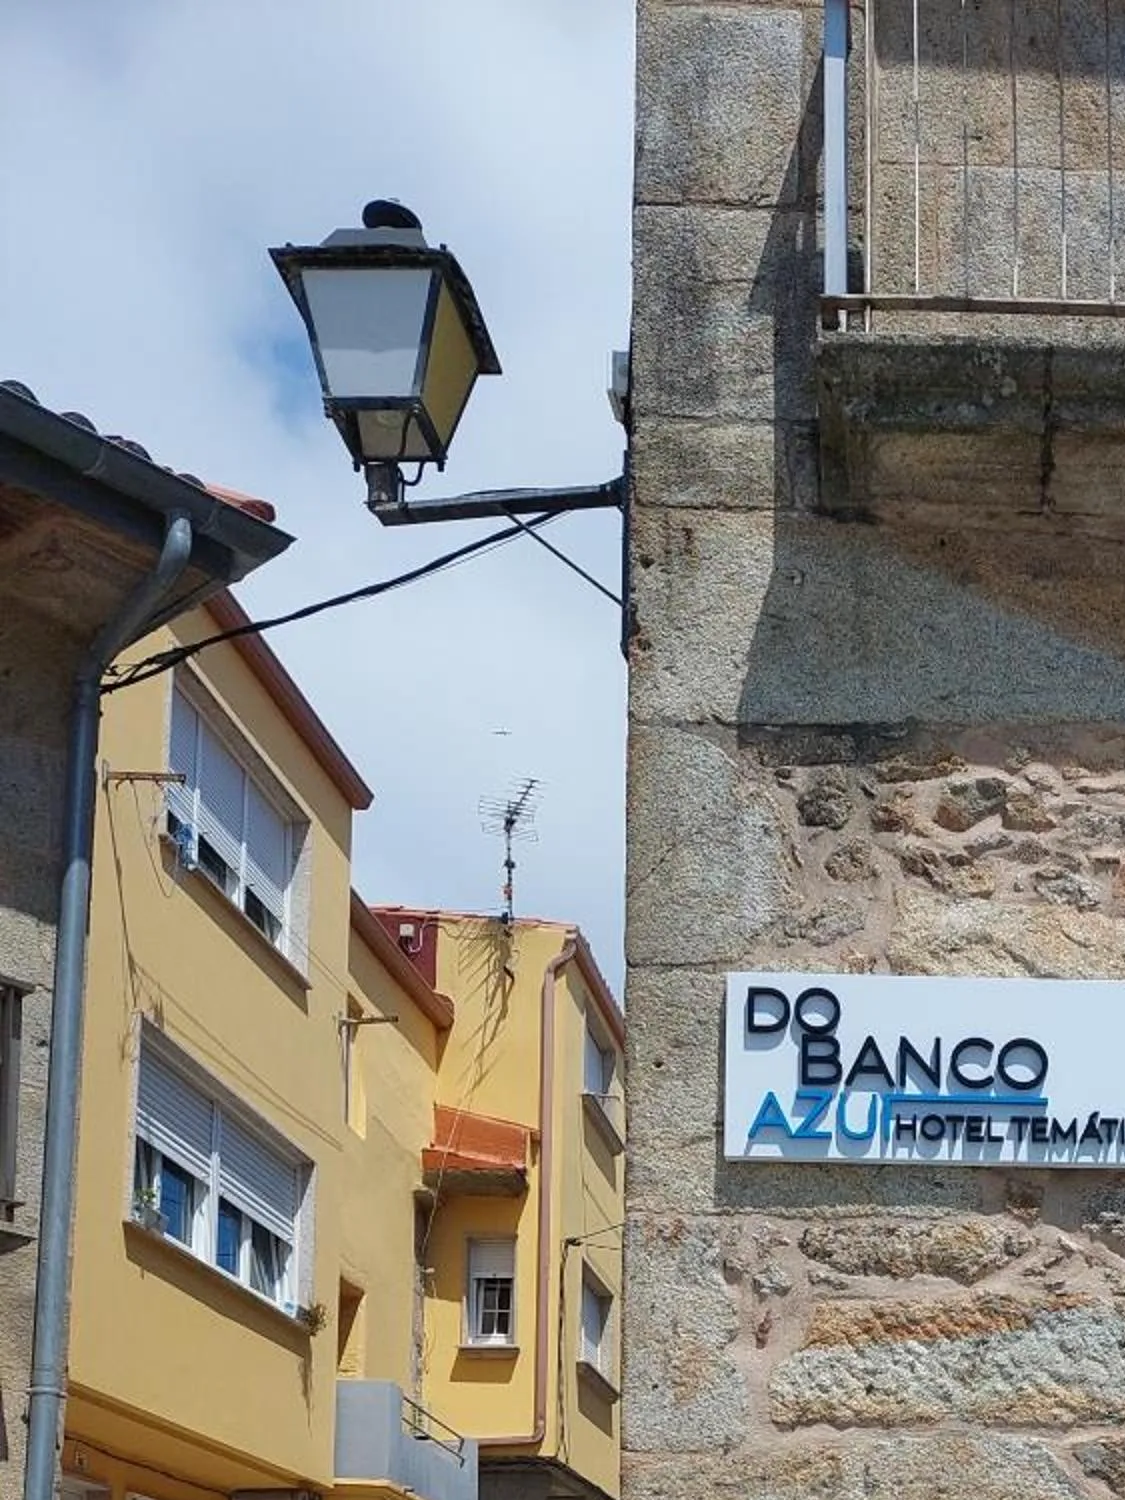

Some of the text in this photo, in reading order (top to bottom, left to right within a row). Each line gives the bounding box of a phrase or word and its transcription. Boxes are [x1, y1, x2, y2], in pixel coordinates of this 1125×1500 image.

[747, 986, 841, 1034] DO
[801, 1034, 1049, 1090] BANCO
[896, 1113, 1004, 1143] HOTEL
